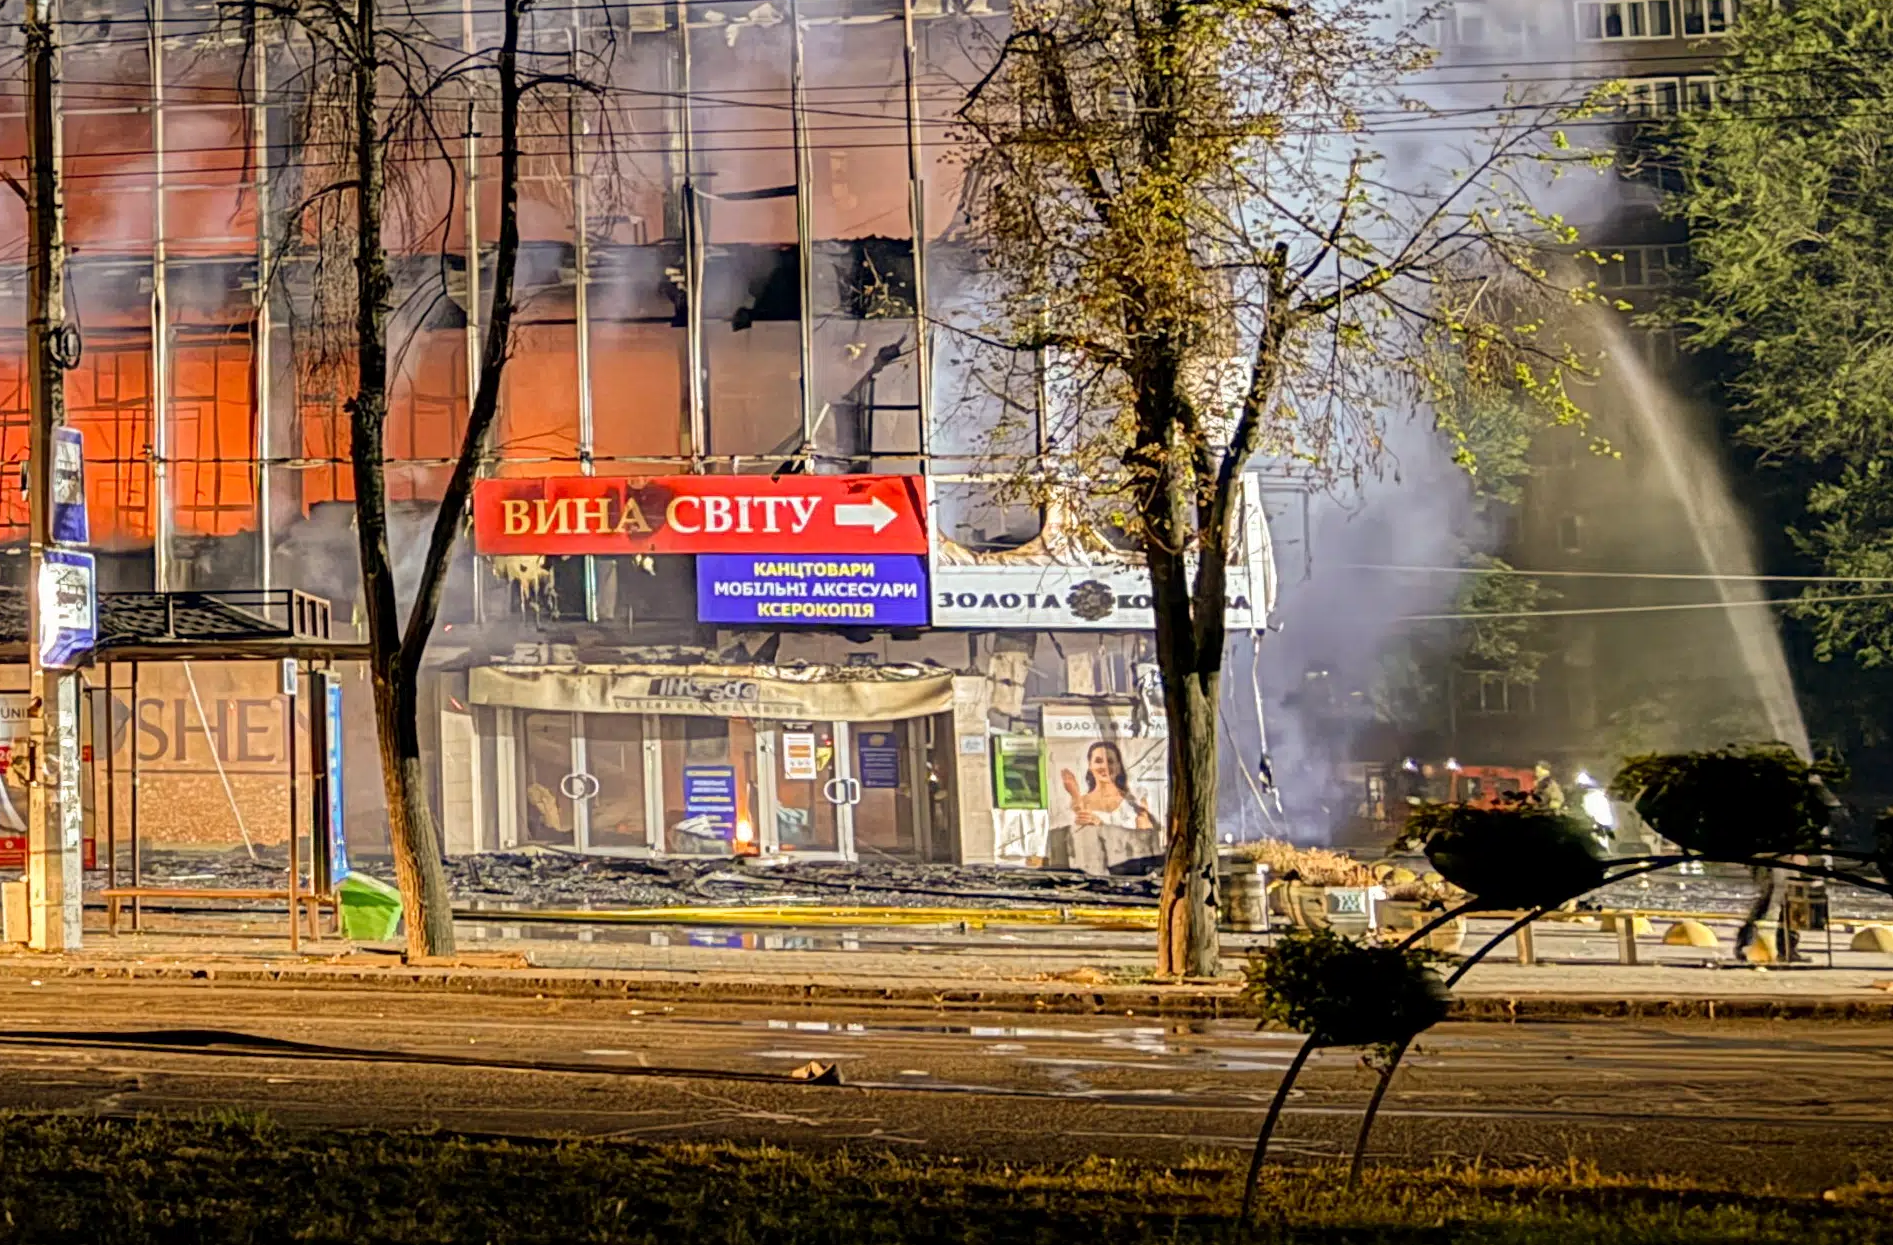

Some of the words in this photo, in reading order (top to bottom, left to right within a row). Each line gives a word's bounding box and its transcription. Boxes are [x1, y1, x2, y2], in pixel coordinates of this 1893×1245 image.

[501, 497, 653, 535] ВИНА
[665, 496, 822, 534] СВІТУ
[754, 562, 875, 579] КАНЦТОВАРИ
[714, 582, 808, 596] МОБІЛЬНІ
[811, 582, 918, 598] АКСЕСУАРИ
[937, 592, 1062, 609] ЗОЛОТА
[757, 602, 875, 618] КСЕРОКОПІЯ
